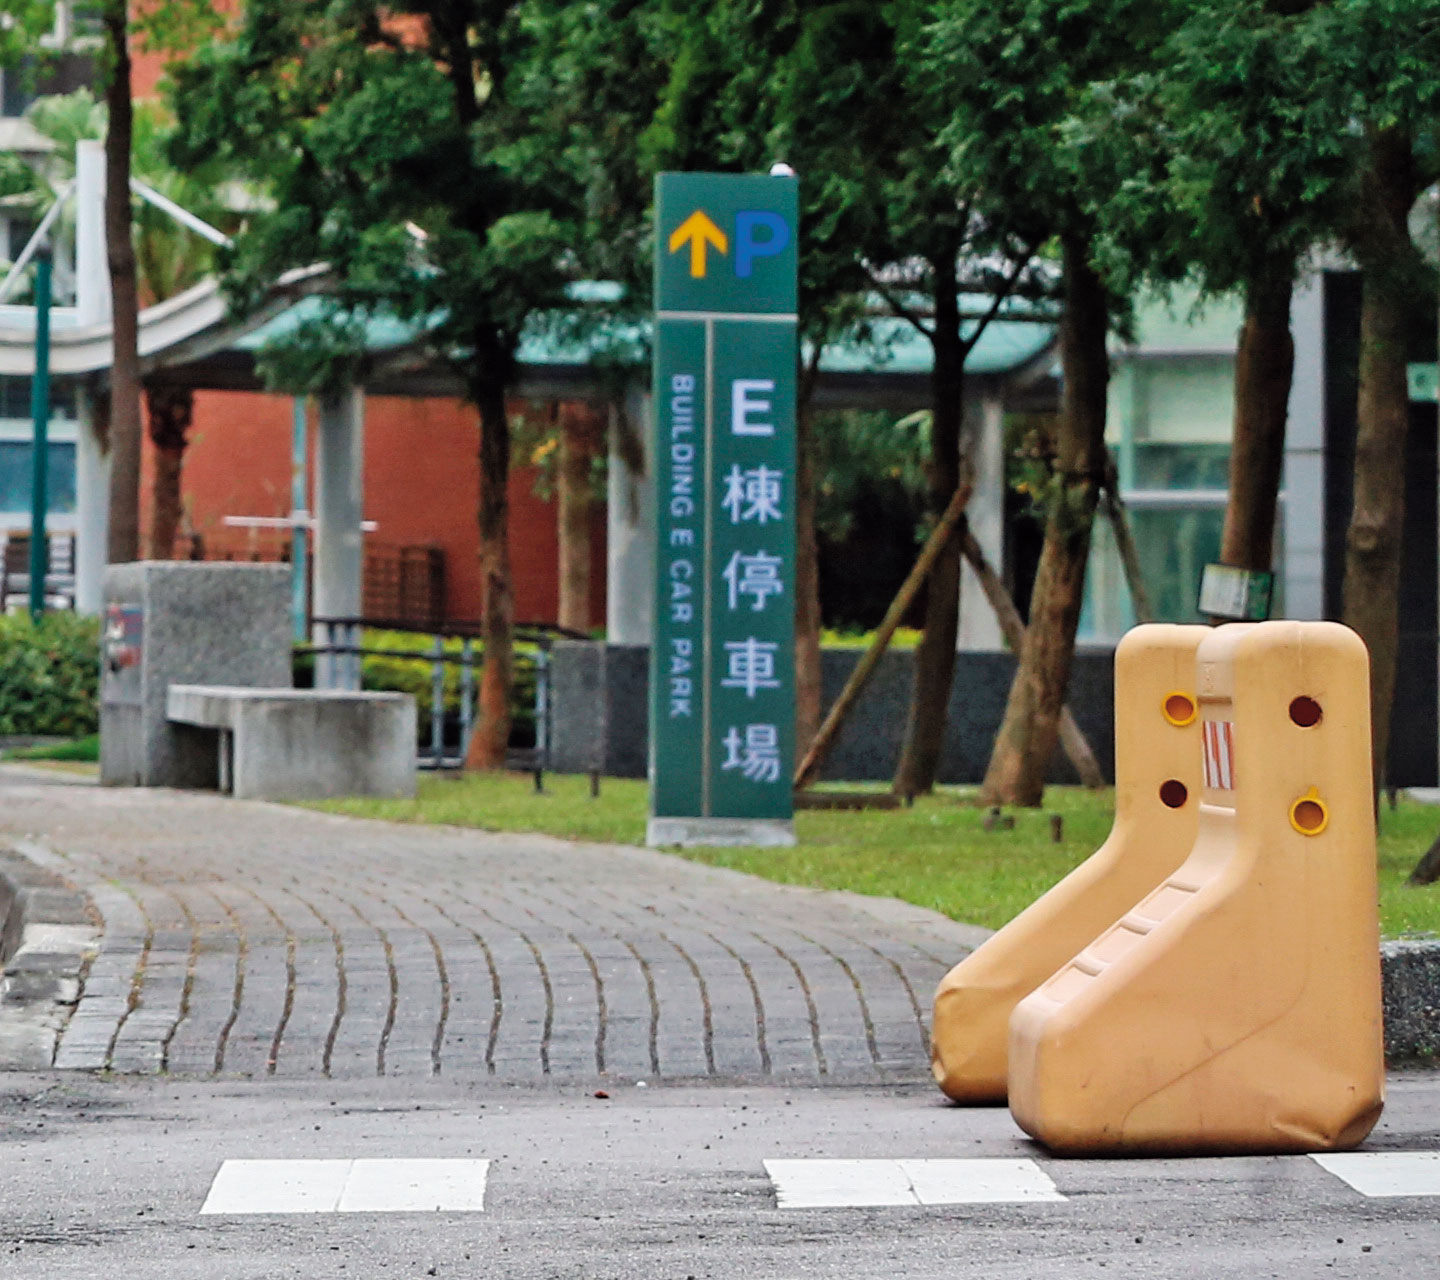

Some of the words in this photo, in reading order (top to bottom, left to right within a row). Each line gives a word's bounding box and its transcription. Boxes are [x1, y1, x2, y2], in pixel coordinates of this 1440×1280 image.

[734, 210, 790, 278] P
[671, 373, 695, 516] BUILDING
[670, 528, 694, 546] E
[668, 559, 694, 623] CAR
[720, 378, 784, 783] E棟停車場
[668, 637, 694, 717] PARK
